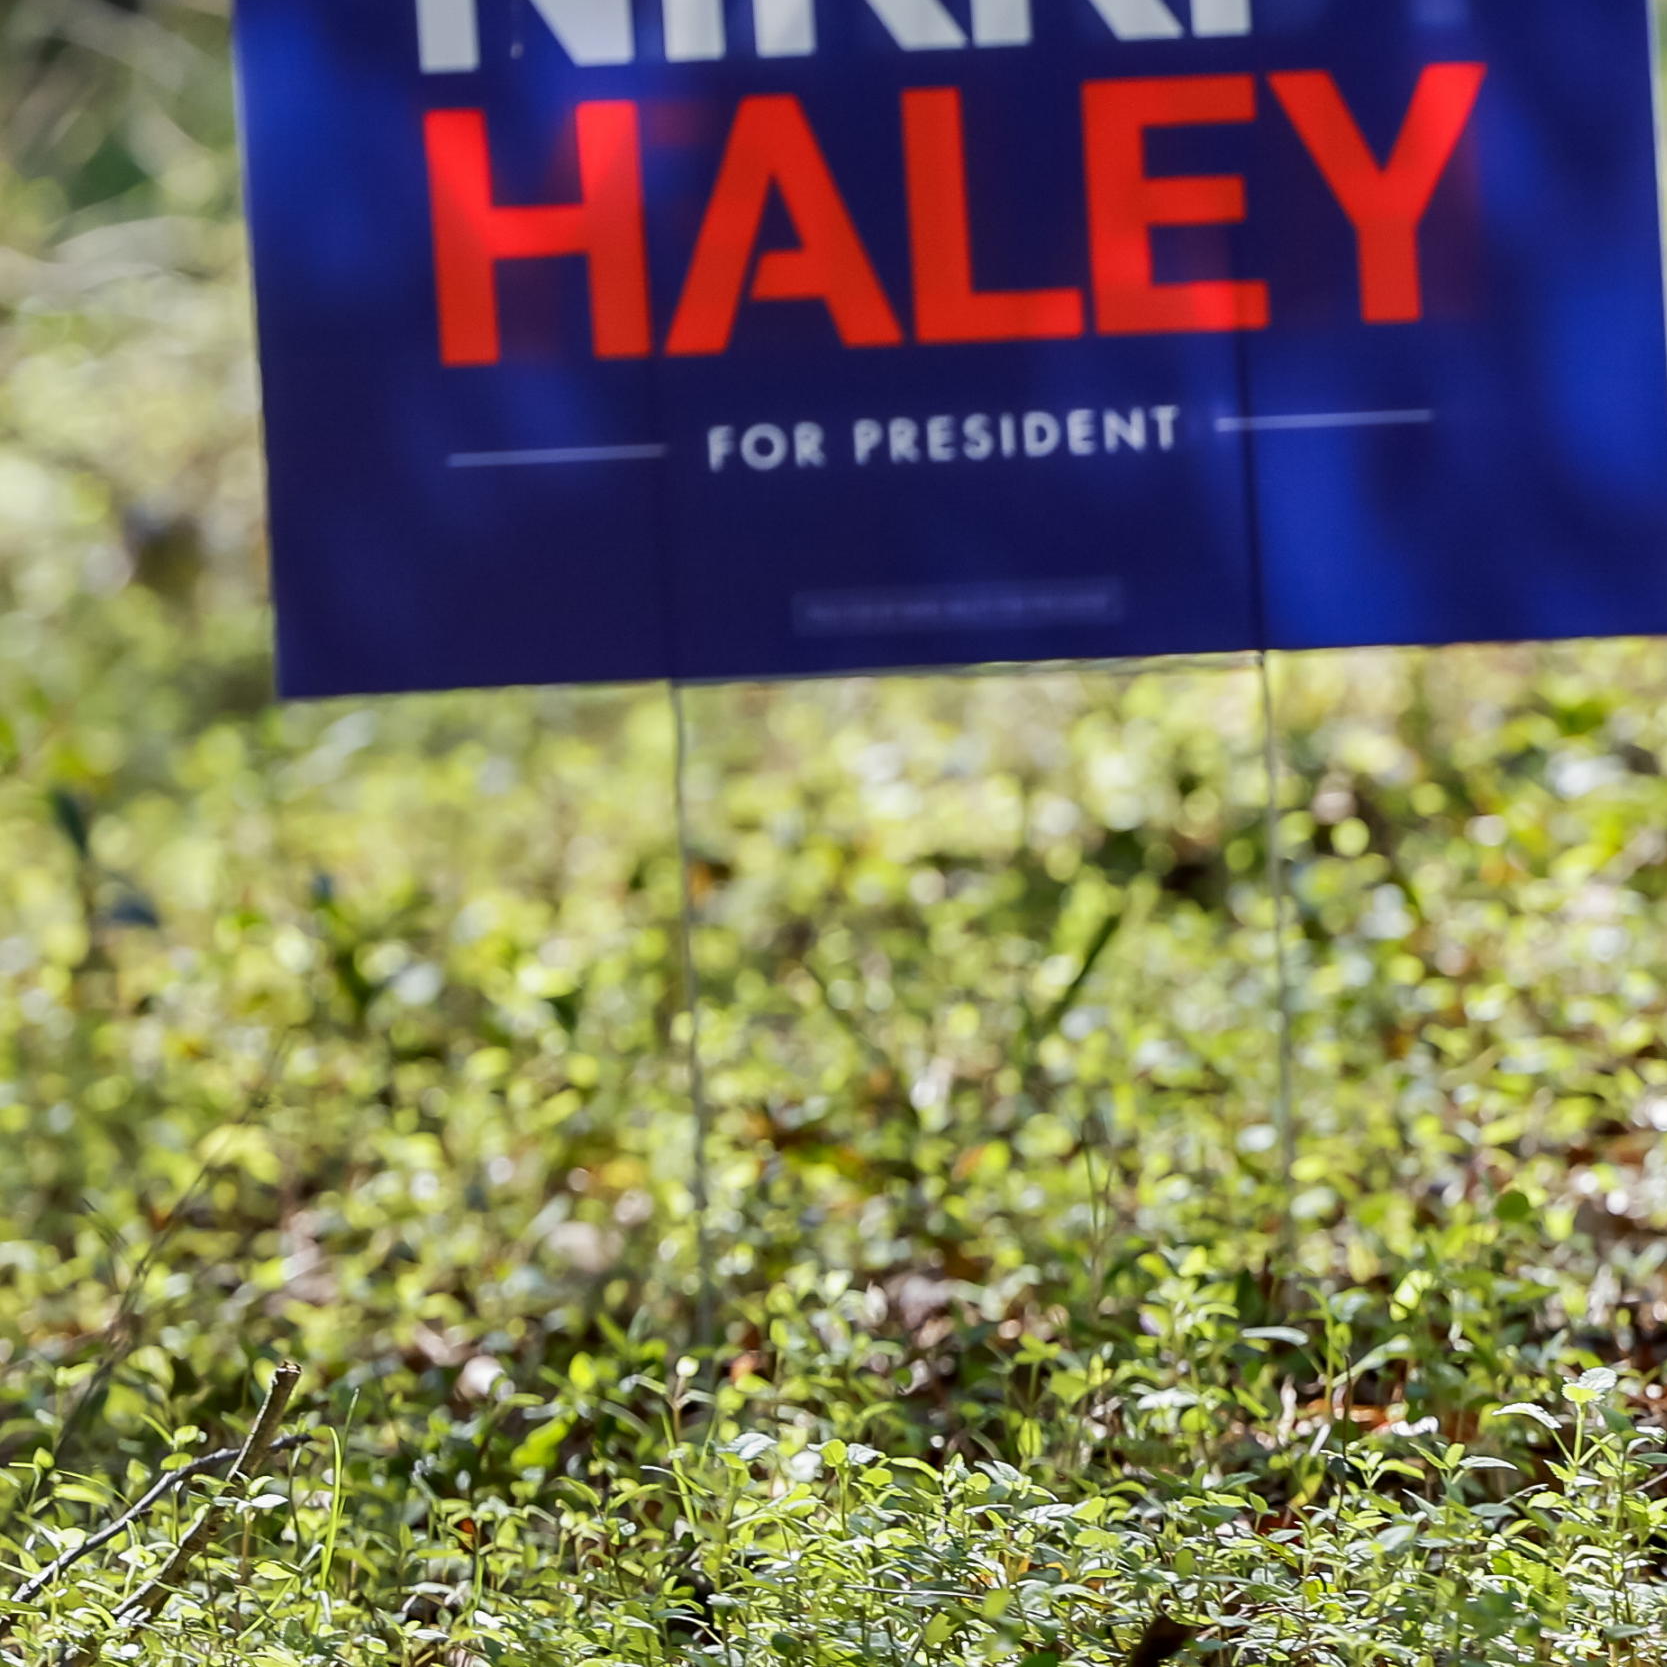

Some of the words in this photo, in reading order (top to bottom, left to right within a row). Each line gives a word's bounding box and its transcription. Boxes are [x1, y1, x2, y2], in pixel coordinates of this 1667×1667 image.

[422, 62, 1487, 366] HALEY
[707, 421, 827, 472] FOR
[853, 404, 1179, 466] PRESIDENT
